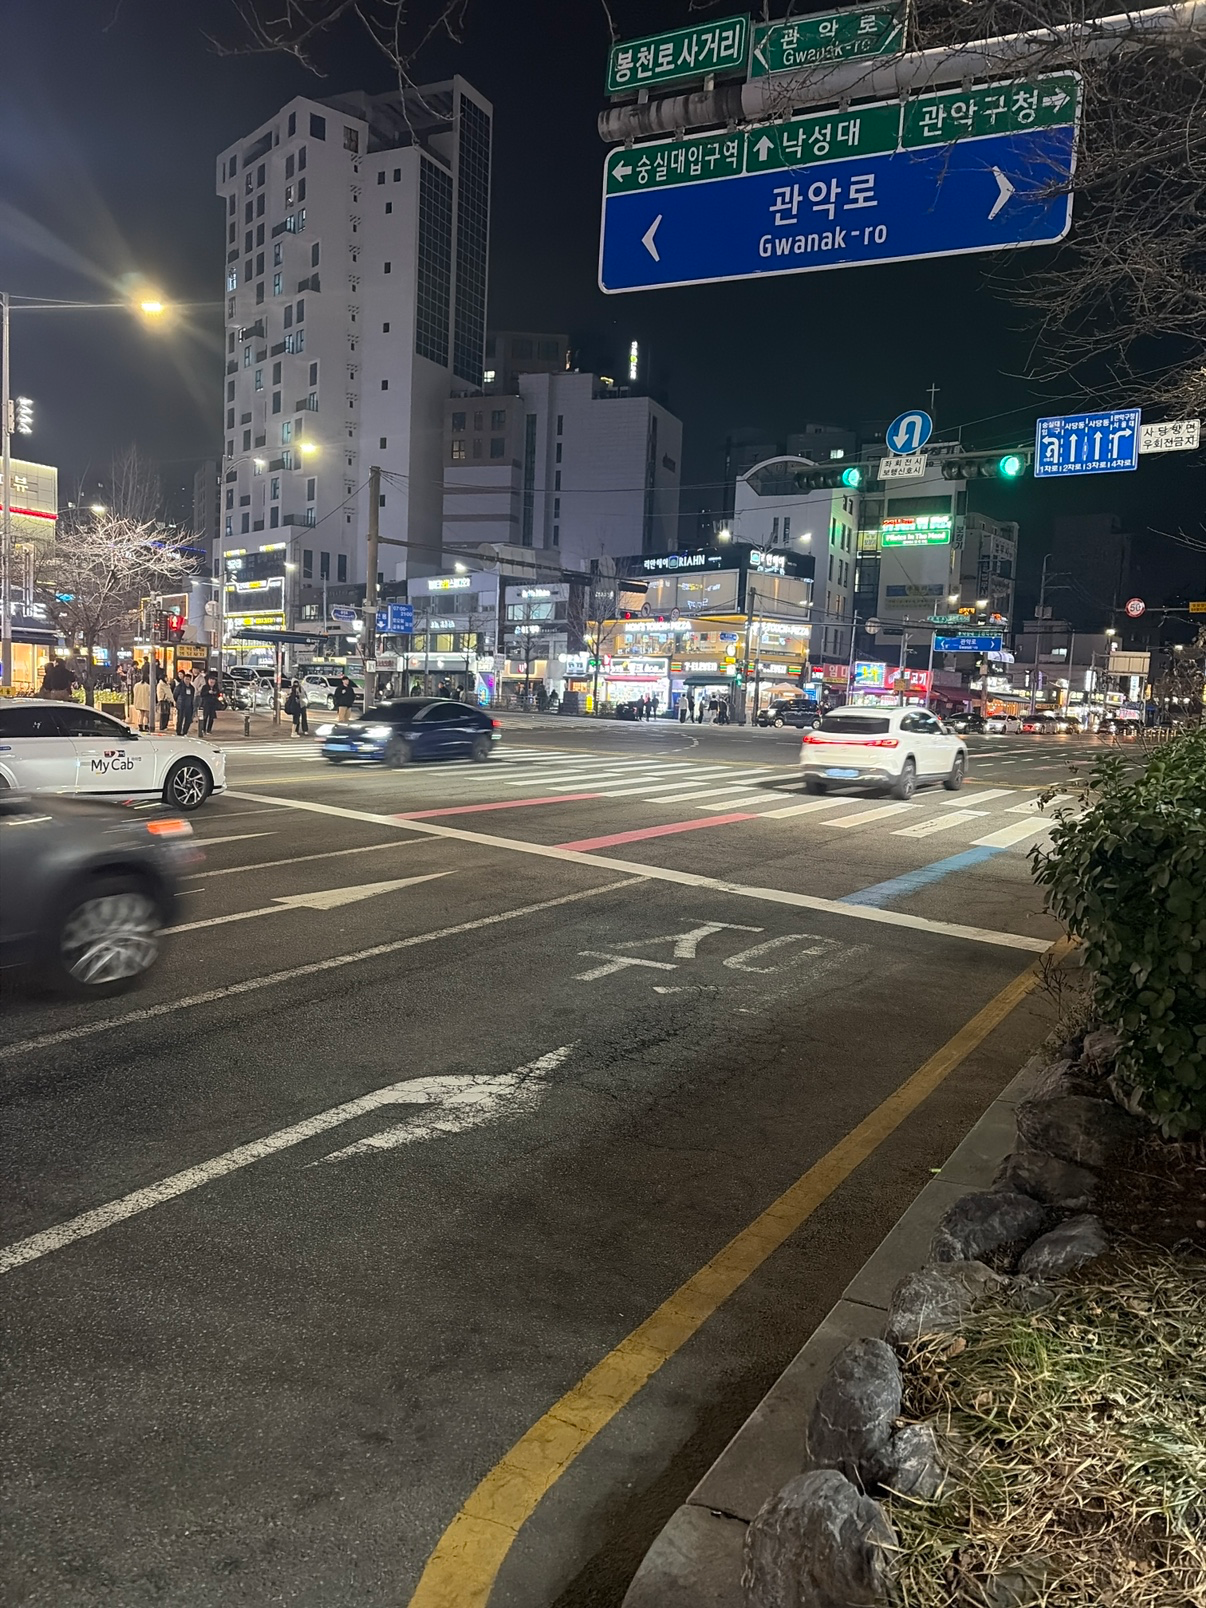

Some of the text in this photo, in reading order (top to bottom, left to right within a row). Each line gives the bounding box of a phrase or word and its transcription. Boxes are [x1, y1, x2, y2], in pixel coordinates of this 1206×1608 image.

[616, 24, 741, 83] 봉천로사거리
[918, 89, 1038, 137] 관악구청
[782, 119, 860, 158] 낙성대
[636, 139, 739, 184] 숭실대입구역
[769, 173, 878, 226] 관악로
[759, 224, 887, 258] Gwanak-ro
[1042, 420, 1061, 429] 숭실대
[1065, 421, 1085, 430] 사당동
[1088, 418, 1109, 427] 사당동
[1142, 435, 1195, 450] 우회전금지
[1063, 462, 1082, 472] 2차로
[1086, 461, 1107, 470] 3차로
[1110, 458, 1132, 467] 4차로
[1040, 464, 1059, 473] 1차로
[678, 554, 706, 567] RIAHN
[1129, 603, 1141, 612] 50
